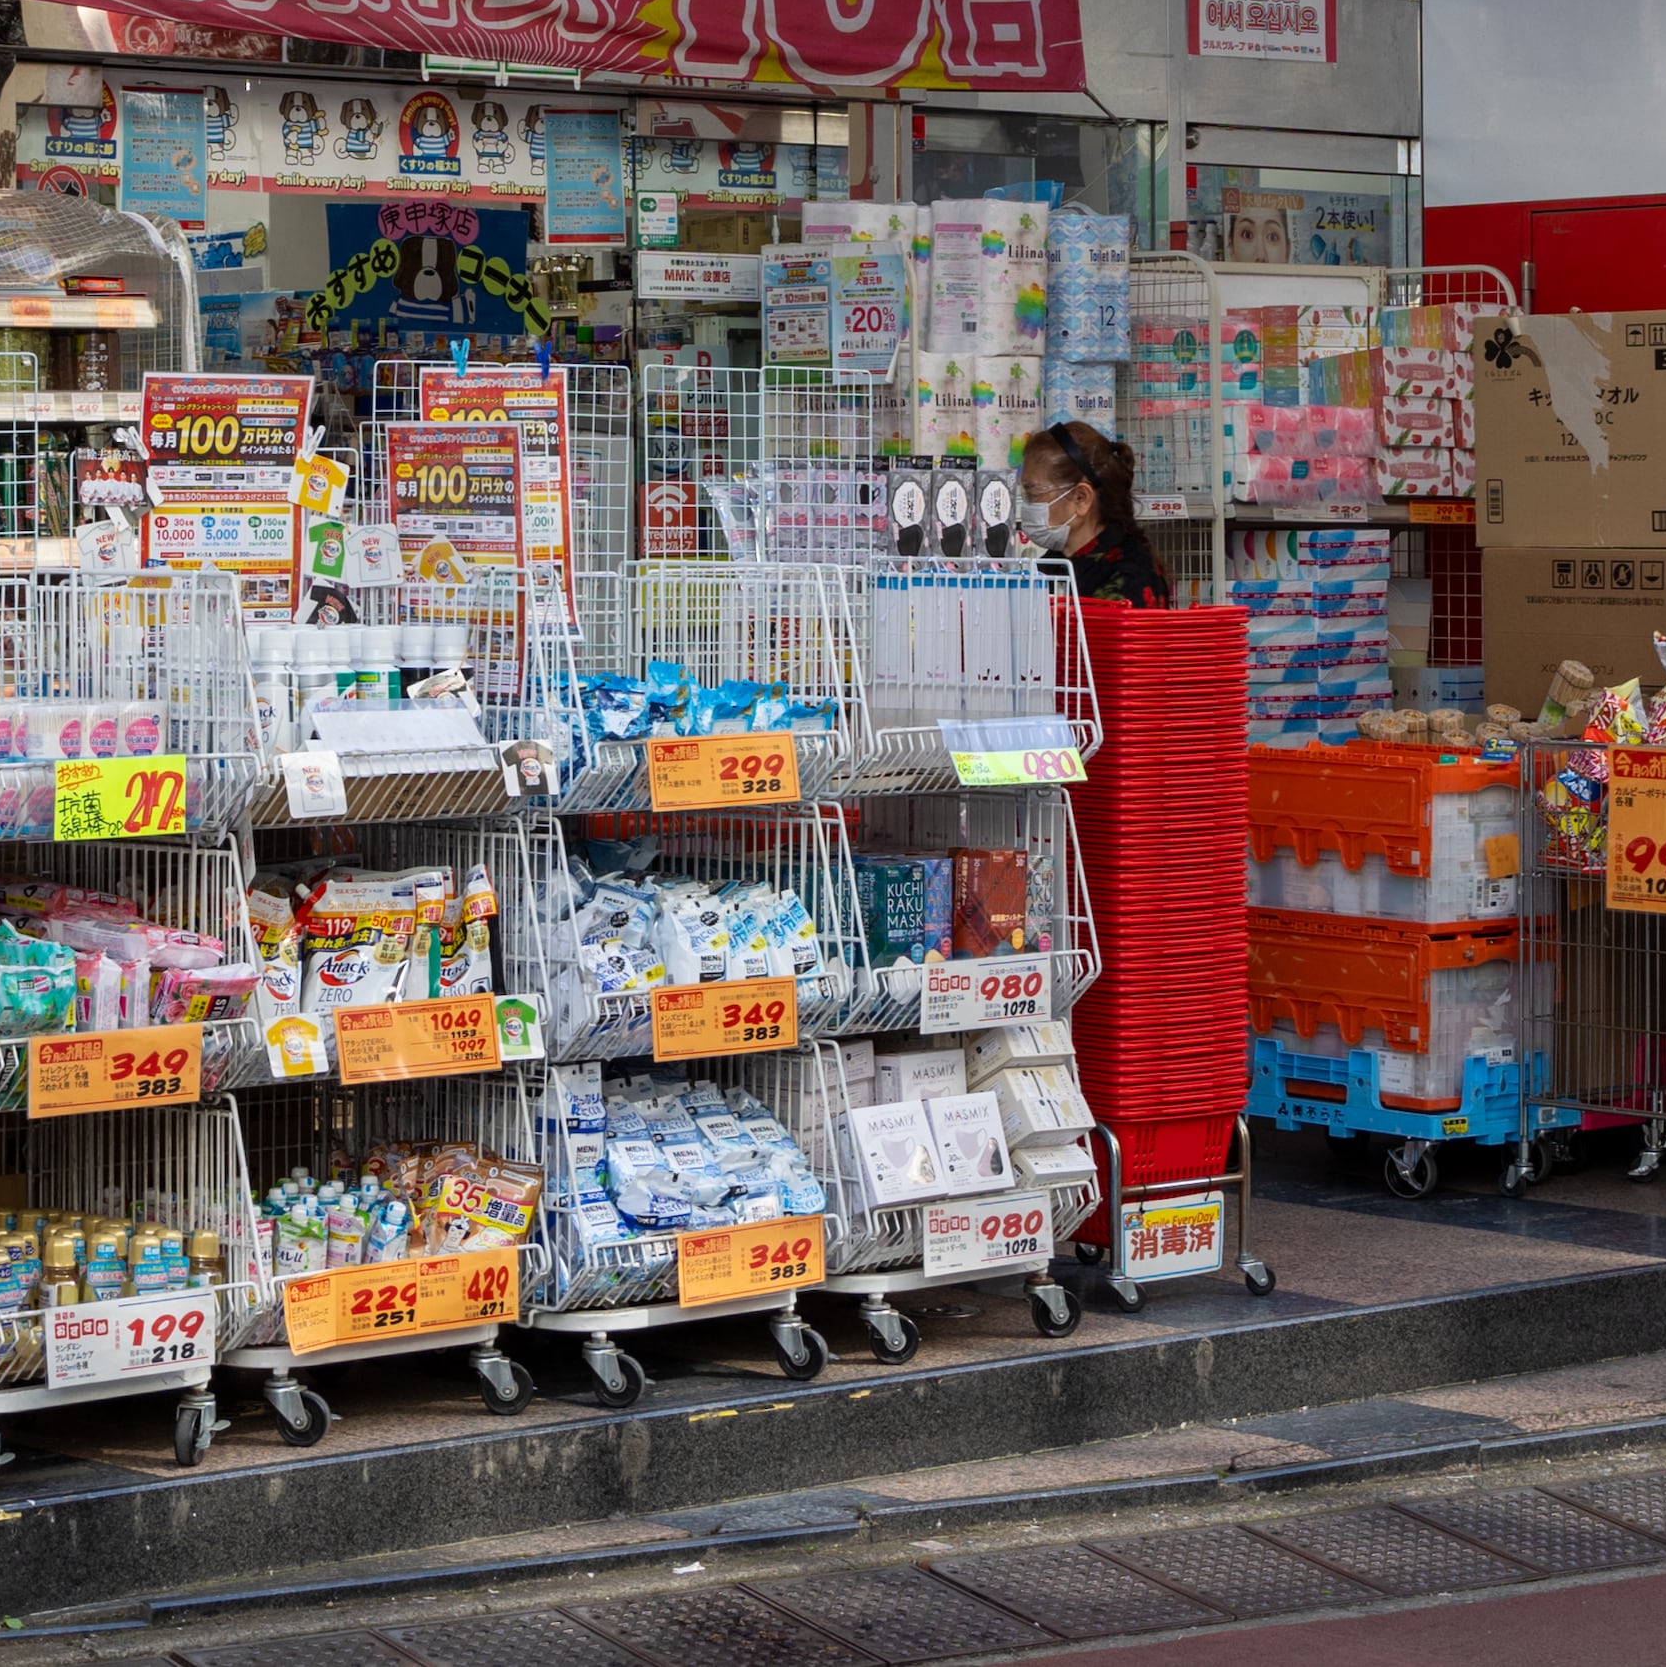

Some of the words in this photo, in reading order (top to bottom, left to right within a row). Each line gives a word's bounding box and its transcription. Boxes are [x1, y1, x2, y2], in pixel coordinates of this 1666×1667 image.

[1205, 0, 1243, 32] 어서
[1245, 2, 1320, 35] 오십시오
[399, 159, 460, 174] くすりの福太郎
[275, 173, 308, 186] Smile
[379, 200, 479, 239] 庚申塚店
[1008, 244, 1044, 261] Lilina
[1089, 248, 1109, 263] Toilet
[1109, 248, 1126, 263] Roll
[664, 268, 695, 283] MMK
[702, 270, 731, 283] 設置店
[306, 245, 397, 331] おすすめ
[935, 393, 972, 408] Lilina
[175, 414, 240, 455] 100
[415, 465, 468, 504] 100
[156, 529, 195, 541] 10,000
[205, 529, 238, 541] 5,000
[253, 528, 284, 540] 1,000
[718, 753, 786, 781] 299
[1023, 750, 1077, 781] 980
[742, 779, 782, 794] 328
[886, 882, 924, 898] KUCHI
[886, 896, 924, 913] RAKU
[886, 913, 924, 929] MASK
[316, 955, 370, 976] Attack
[317, 988, 353, 1003] ZERO
[980, 971, 1043, 1001] 980
[722, 1001, 786, 1029] 349
[1002, 999, 1037, 1016] 1078
[430, 1009, 482, 1031] 1049
[742, 1025, 781, 1042] 383
[39, 1039, 103, 1064] 今月のお買得品
[450, 1038, 486, 1054] 1997
[110, 1049, 189, 1081] 349
[135, 1076, 182, 1097] 383
[867, 1114, 917, 1134] MASMIX
[980, 1209, 1044, 1241] 980
[1144, 1215, 1171, 1230] Smile
[1129, 1221, 1216, 1261] 消毒済
[748, 1237, 813, 1270] 349
[466, 1266, 510, 1302] 429
[126, 1310, 205, 1346] 199
[151, 1342, 196, 1364] 218
